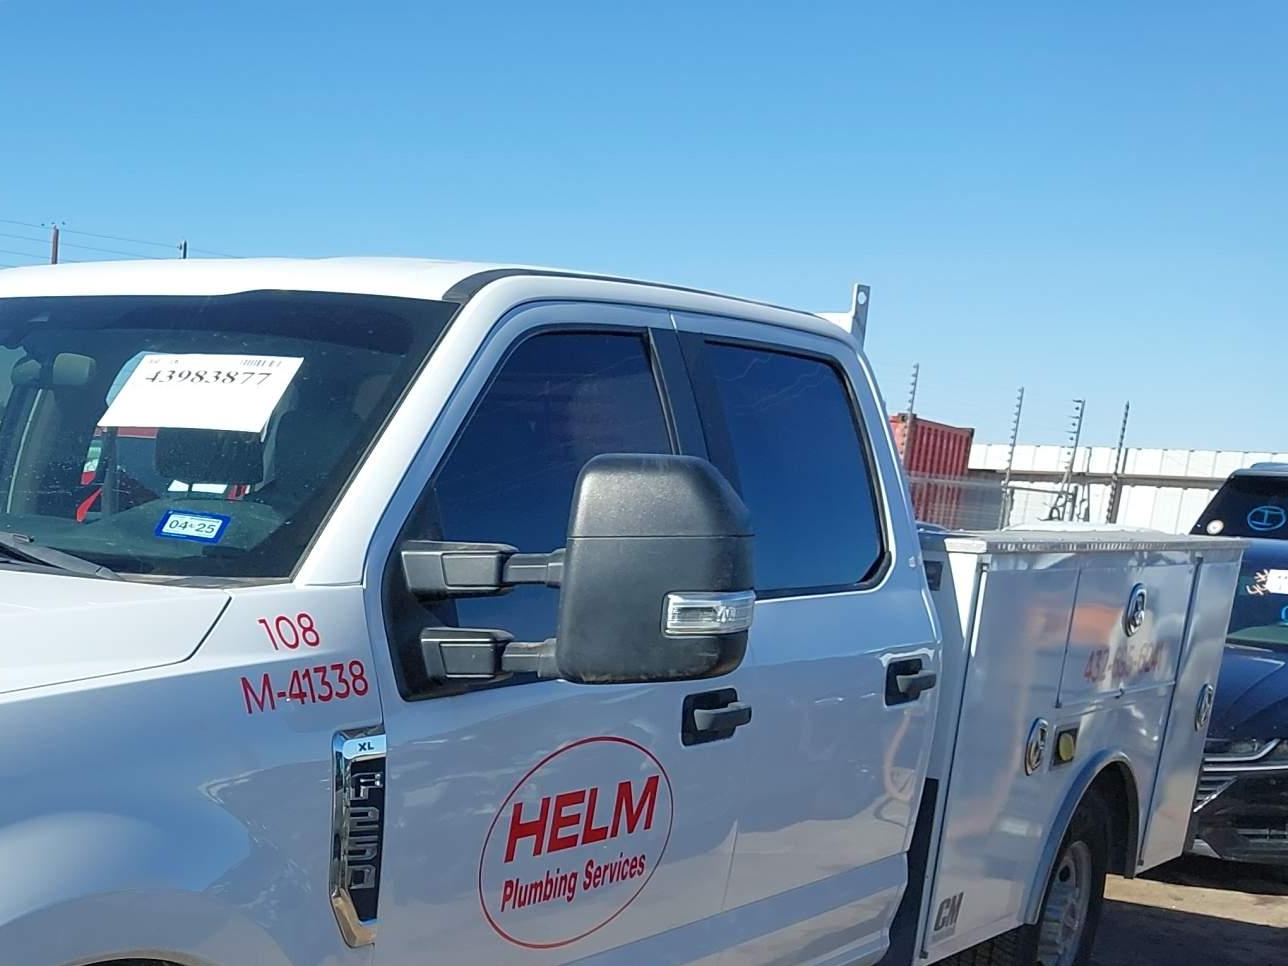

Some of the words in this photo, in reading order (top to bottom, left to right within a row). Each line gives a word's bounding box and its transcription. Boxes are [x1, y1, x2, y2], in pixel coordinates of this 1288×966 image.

[144, 369, 273, 385] 43983877
[168, 519, 189, 531] 04
[195, 522, 217, 534] 25
[257, 612, 321, 651] 108
[240, 660, 369, 715] M-41338
[358, 741, 375, 752] XL
[503, 774, 660, 864] HELM
[500, 867, 579, 913] Plumbing
[583, 851, 646, 891] Services
